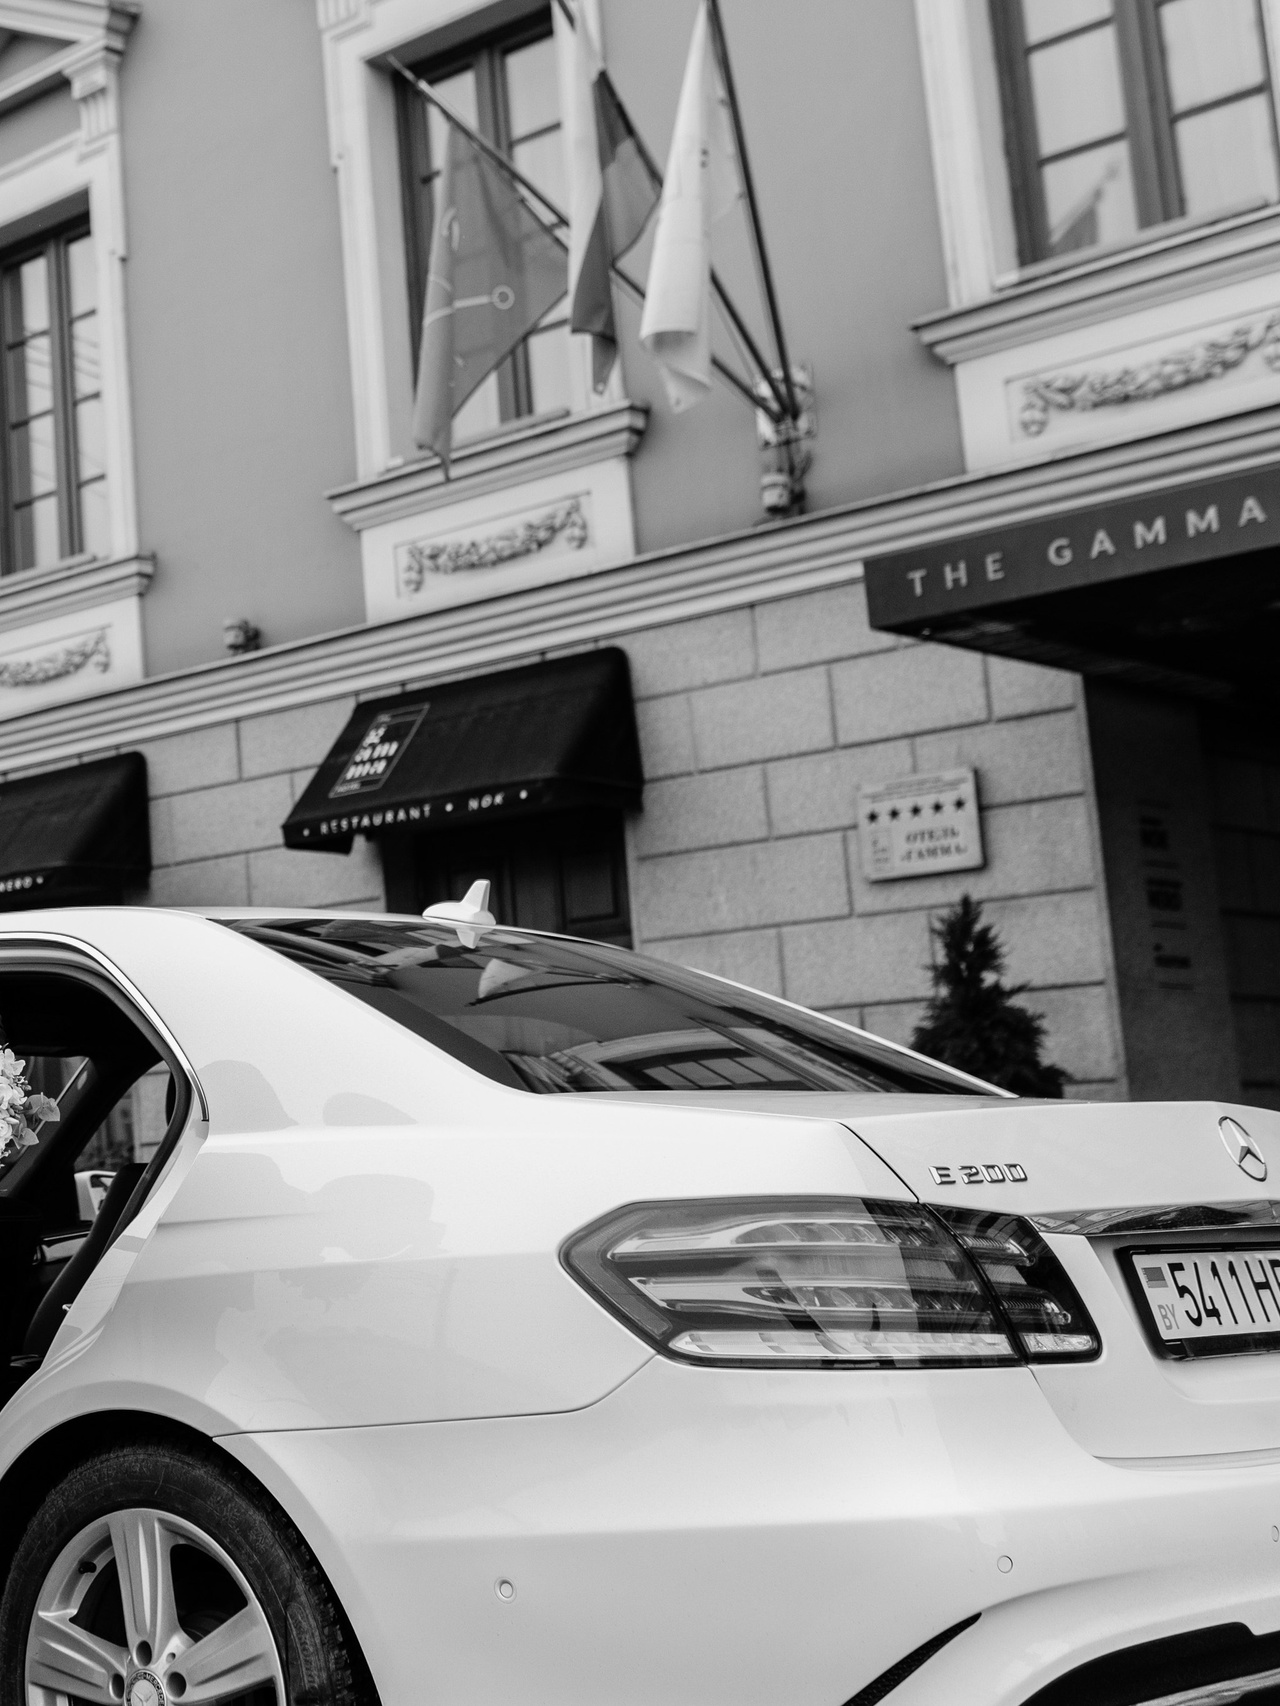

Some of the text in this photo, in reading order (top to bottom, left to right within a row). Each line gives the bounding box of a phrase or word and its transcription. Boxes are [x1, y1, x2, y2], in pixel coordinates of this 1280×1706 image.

[906, 496, 1268, 598] THE GAMMA
[319, 803, 432, 836] RESTAURANT
[928, 1162, 1029, 1186] E 200
[1157, 1303, 1180, 1331] BY
